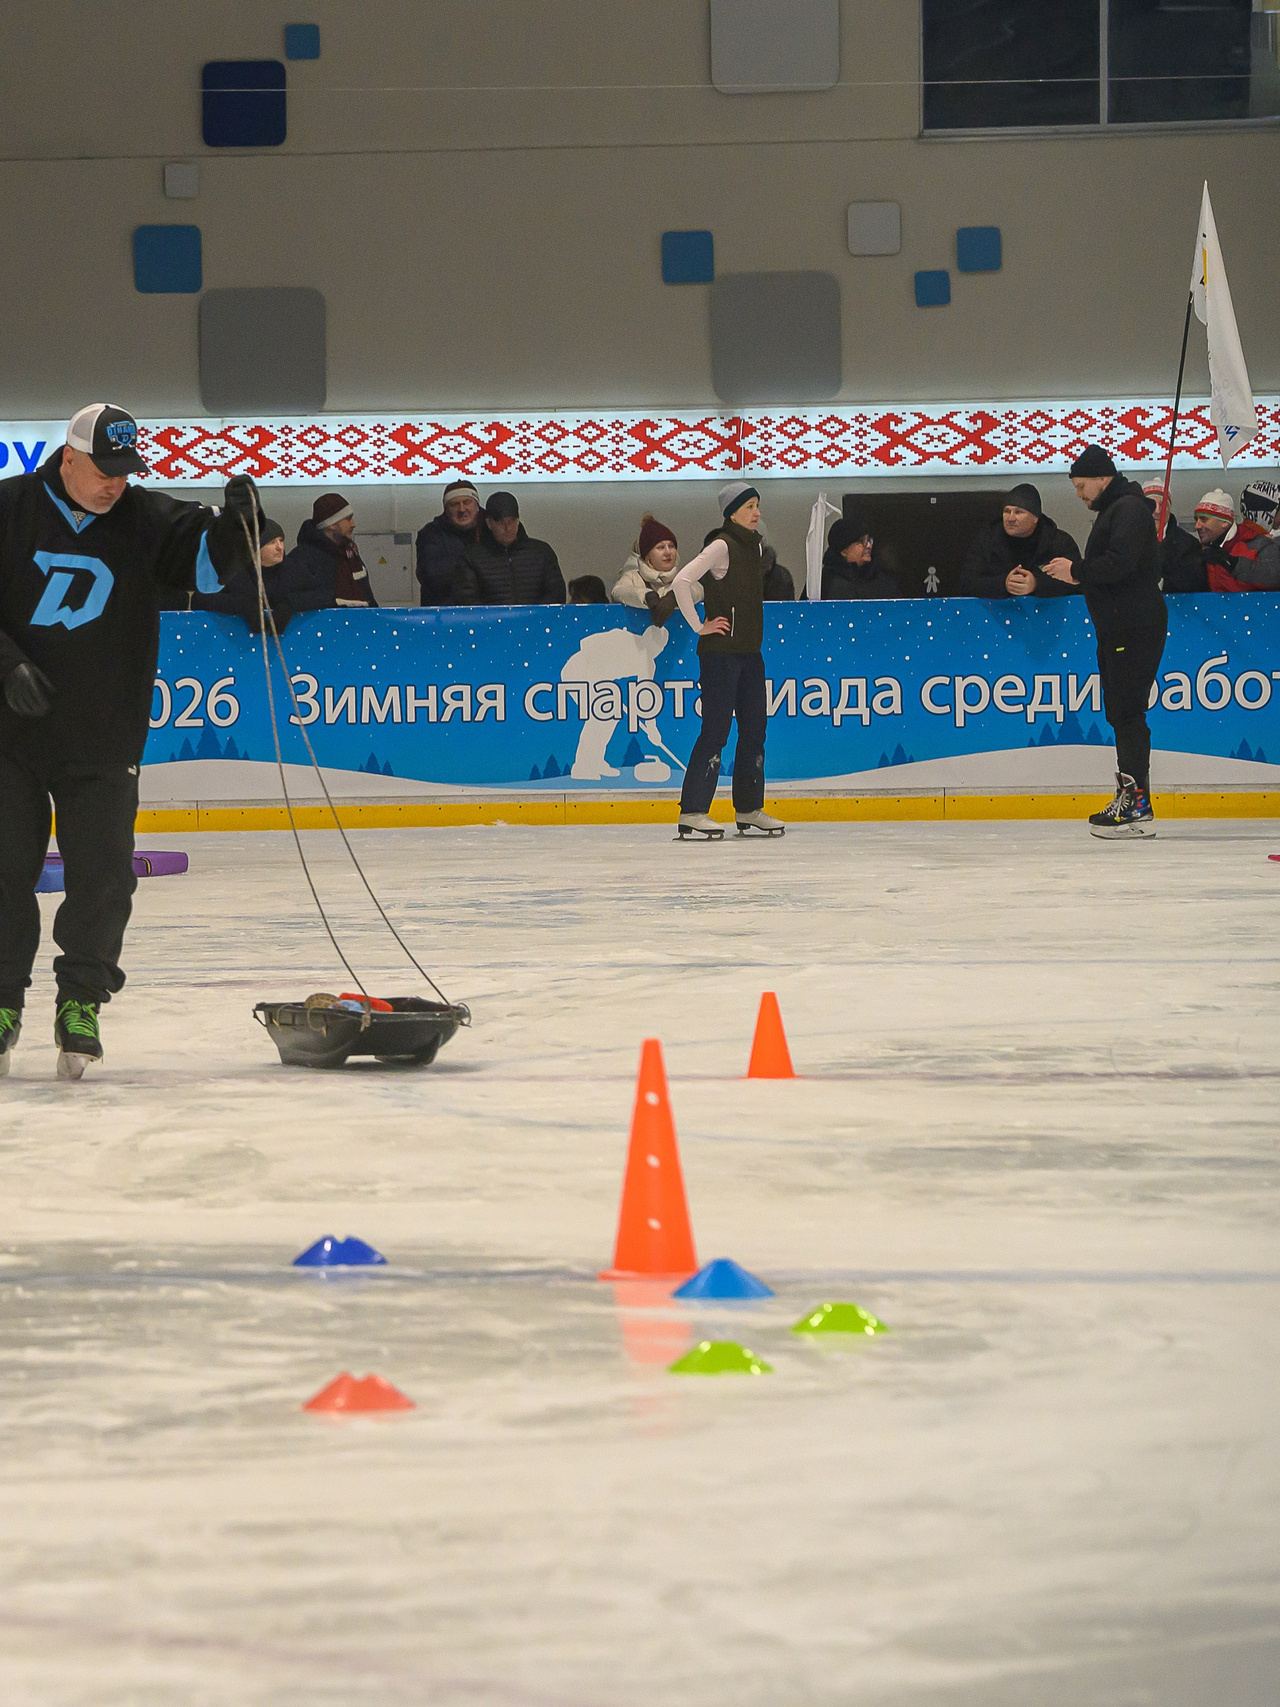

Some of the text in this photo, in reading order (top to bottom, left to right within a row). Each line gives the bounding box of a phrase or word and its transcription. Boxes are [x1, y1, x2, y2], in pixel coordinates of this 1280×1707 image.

[148, 654, 1280, 733] 026 Зимняя спартиада среди або
